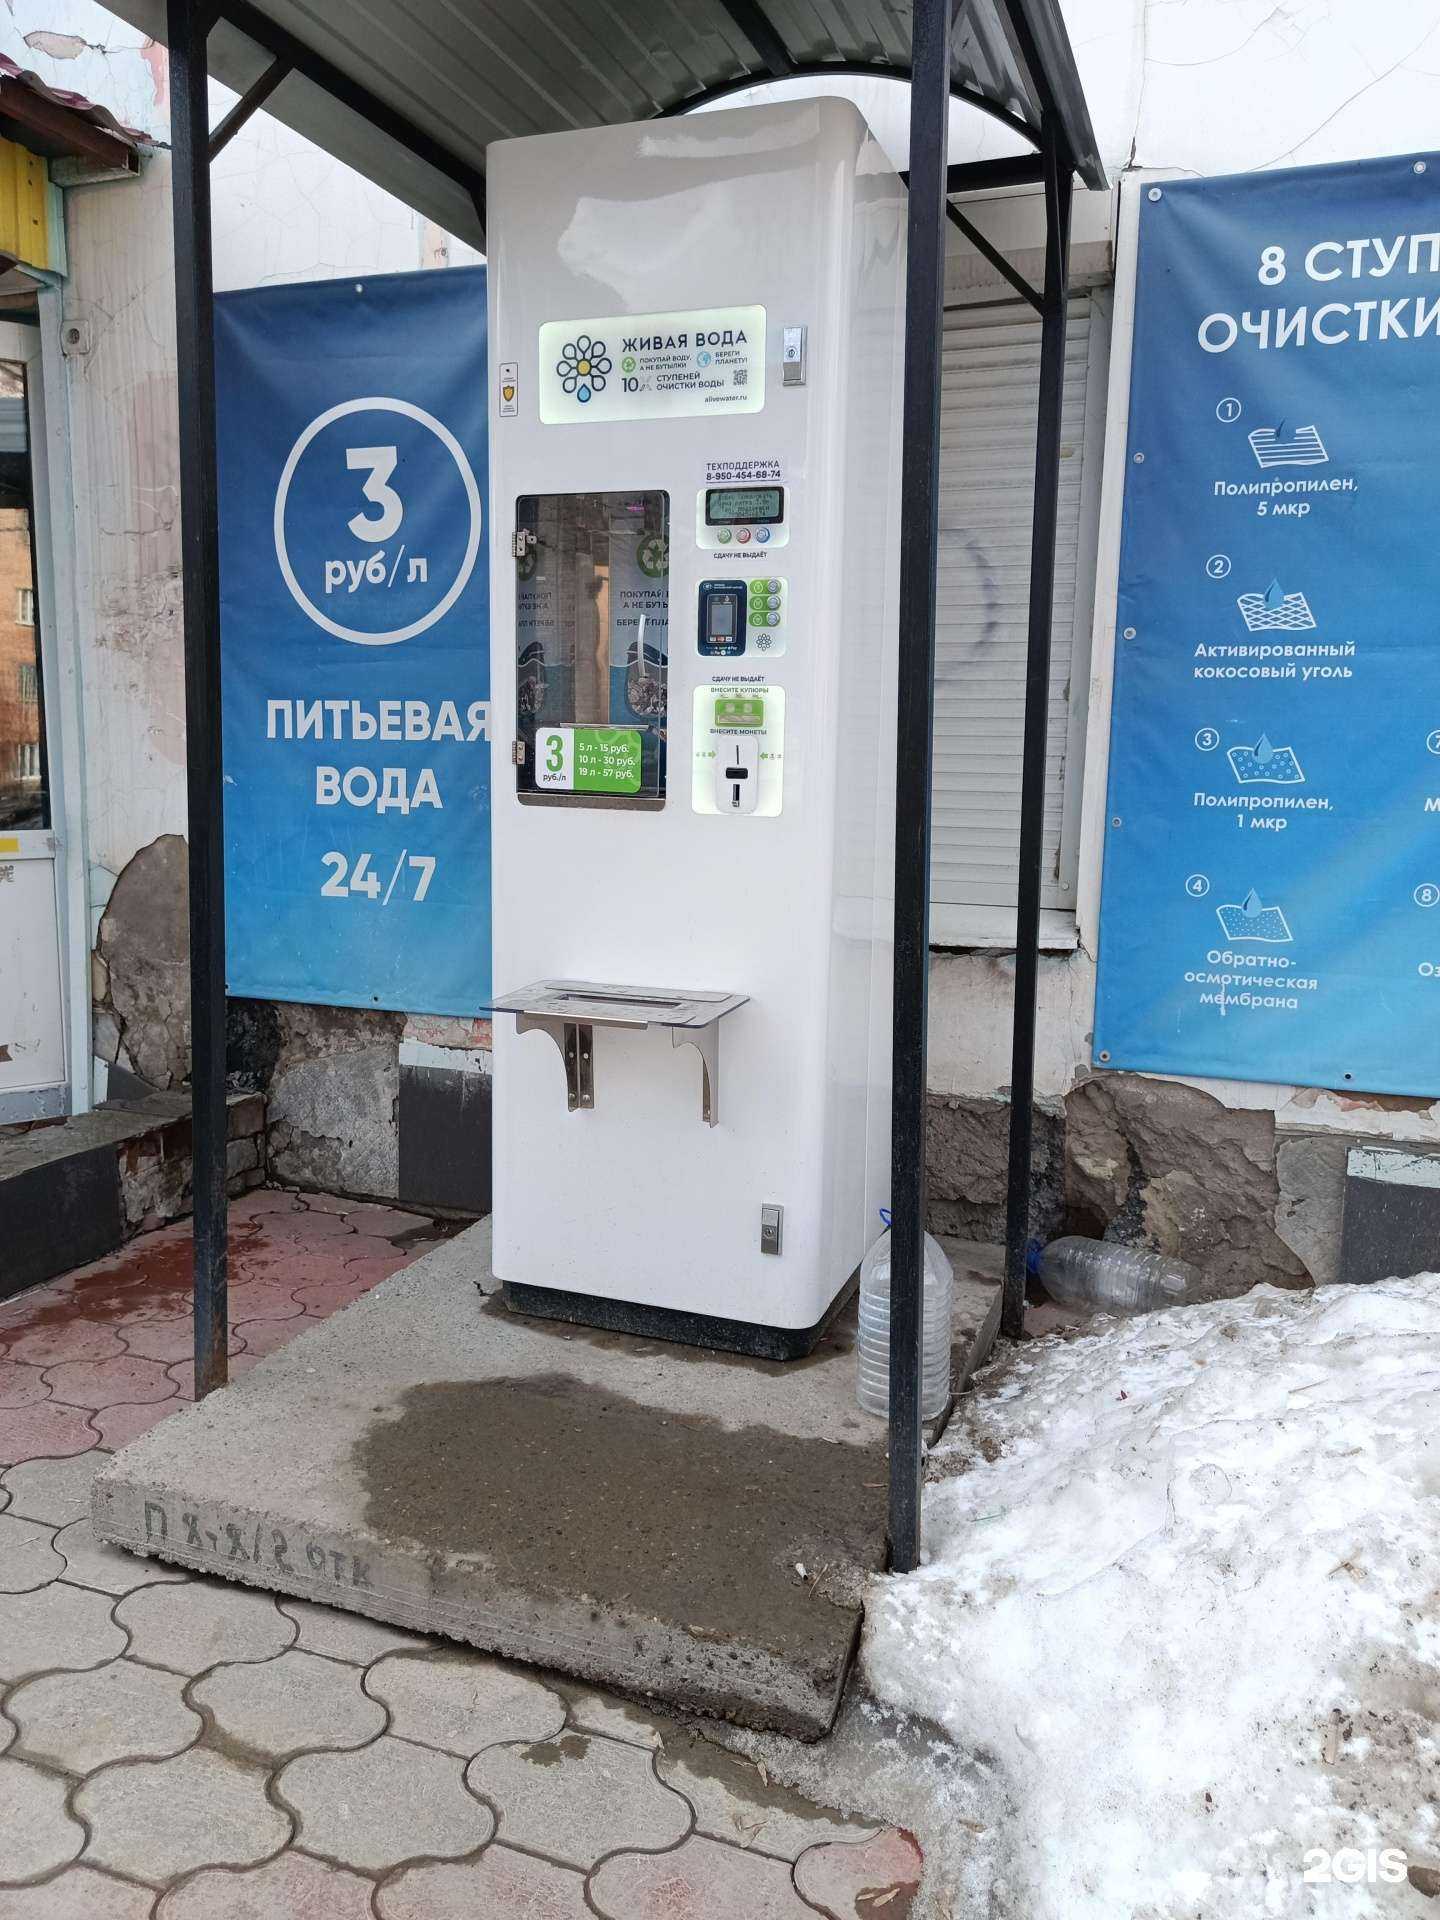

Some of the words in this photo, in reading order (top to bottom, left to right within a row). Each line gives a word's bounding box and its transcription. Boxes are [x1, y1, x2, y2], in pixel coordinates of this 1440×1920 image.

[1258, 246, 1286, 286] 8
[1305, 232, 1440, 282] СТУП
[622, 334, 688, 352] ЖИВАЯ
[696, 330, 747, 348] ВОДА
[640, 355, 671, 364] ПОКУПАЙ
[715, 350, 740, 358] БЕРЕГИ
[655, 362, 687, 370] БУТЫЛКИ
[656, 371, 700, 382] СТУПЕНЕЙ
[656, 381, 696, 391] ОЧИСТКИ
[698, 379, 725, 389] ВОДЫ
[704, 395, 748, 403] alivewater.ru
[1226, 403, 1233, 417] 1
[706, 460, 780, 470] ТЕХПОДДЕРЖКА
[706, 470, 781, 480] 8-950-454-68-74
[345, 445, 403, 544] 3
[1214, 477, 1358, 496] Полипропилен,
[1257, 502, 1267, 516] 5
[1272, 501, 1311, 518] мкр
[325, 546, 428, 594] руб/л
[1214, 560, 1223, 574] 2
[1194, 641, 1355, 661] Активированный
[1194, 663, 1296, 679] кокосовый
[1302, 665, 1352, 681] уголь
[266, 699, 491, 742] ПИТЬЕВАЯ
[1203, 733, 1212, 746] 3
[545, 734, 563, 772] 3
[579, 743, 585, 751] 5
[599, 743, 609, 751] 15
[610, 743, 629, 755] руб.
[579, 755, 589, 764] 10
[616, 756, 636, 769] руб.
[579, 767, 588, 776] 19
[603, 769, 614, 777] 57
[615, 770, 634, 782] руб.
[316, 767, 443, 815] ВОДА
[1193, 793, 1333, 811] Полипропилен,
[1237, 815, 1244, 829] 1
[1251, 815, 1288, 831] мкр
[320, 849, 437, 906] 24/7
[1193, 880, 1202, 892] 4
[1421, 889, 1432, 902] 8
[1206, 950, 1297, 968] Обратно-
[1184, 971, 1318, 990] осмотическая
[1200, 992, 1298, 1009] мембрана
